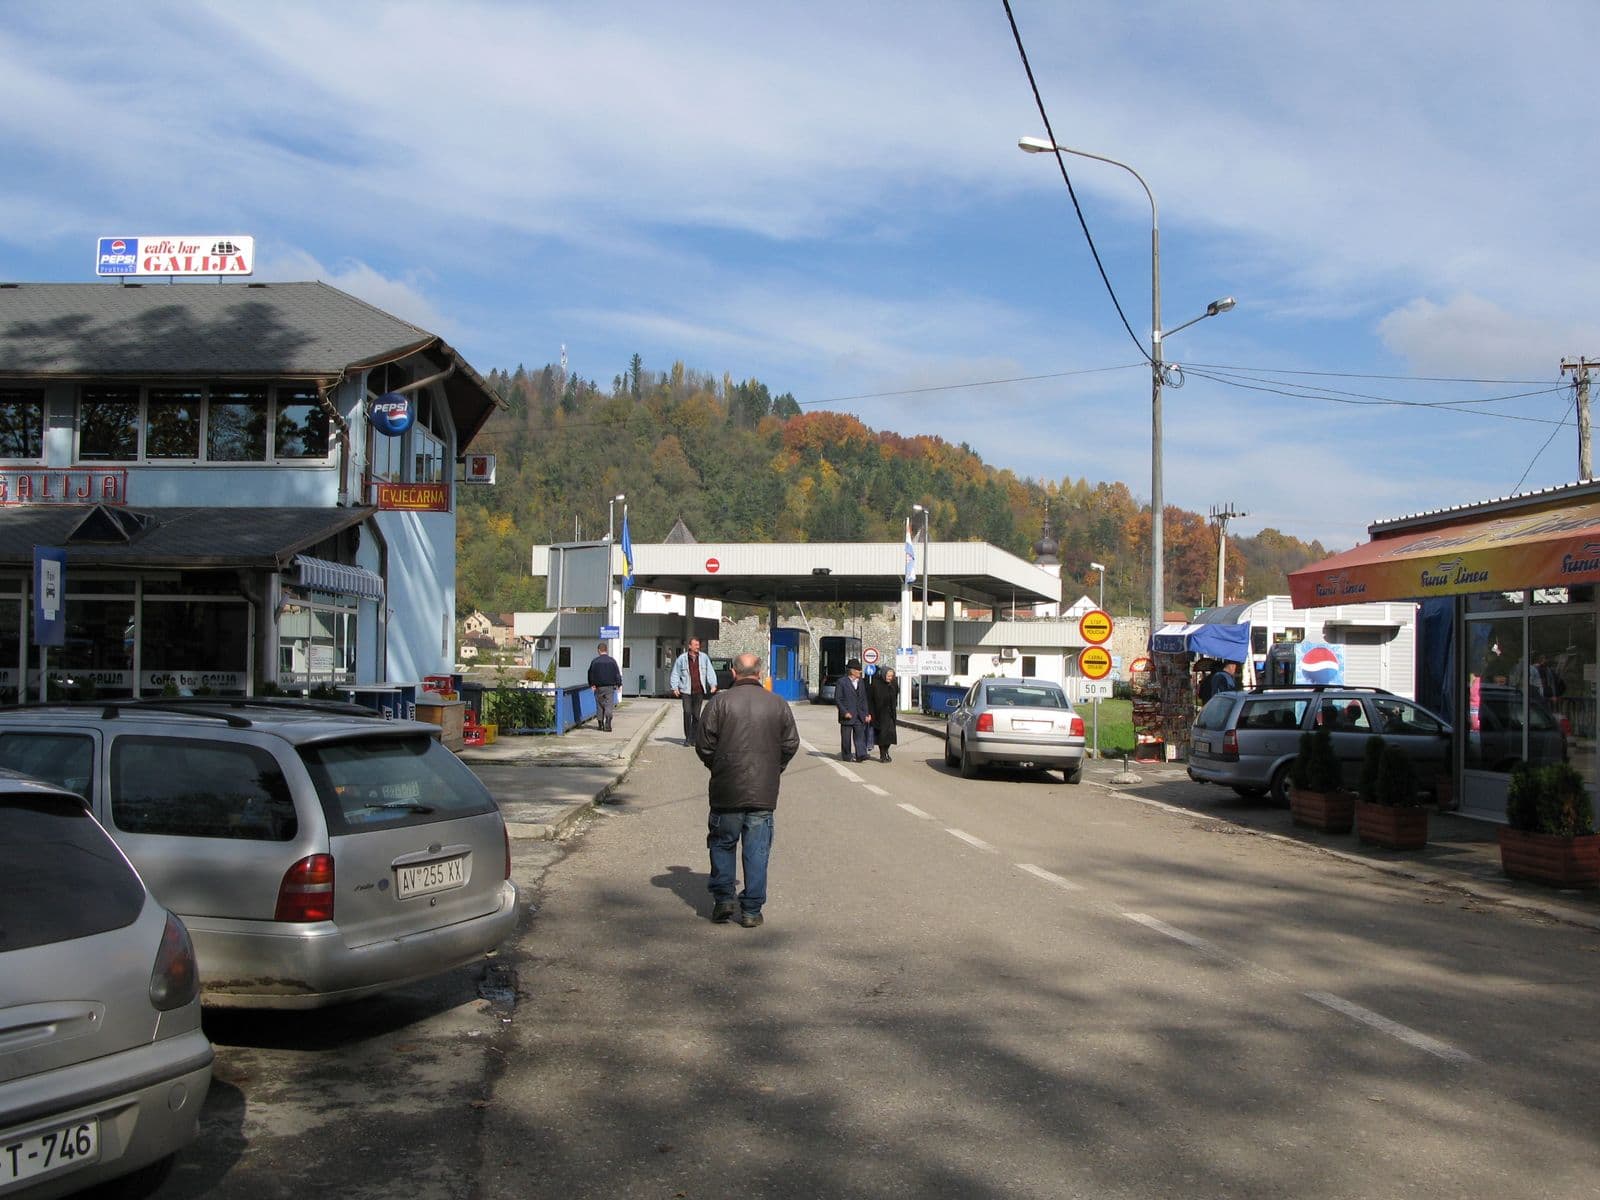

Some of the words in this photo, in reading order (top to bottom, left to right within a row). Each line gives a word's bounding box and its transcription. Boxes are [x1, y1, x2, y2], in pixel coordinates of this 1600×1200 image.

[144, 241, 175, 254] caffe
[178, 241, 200, 254] bar
[100, 254, 136, 265] PEPSI
[143, 256, 247, 271] GALIJA
[374, 401, 408, 413] PEPSI
[1085, 684, 1096, 693] 50
[403, 869, 416, 891] AV
[423, 864, 444, 887] 255
